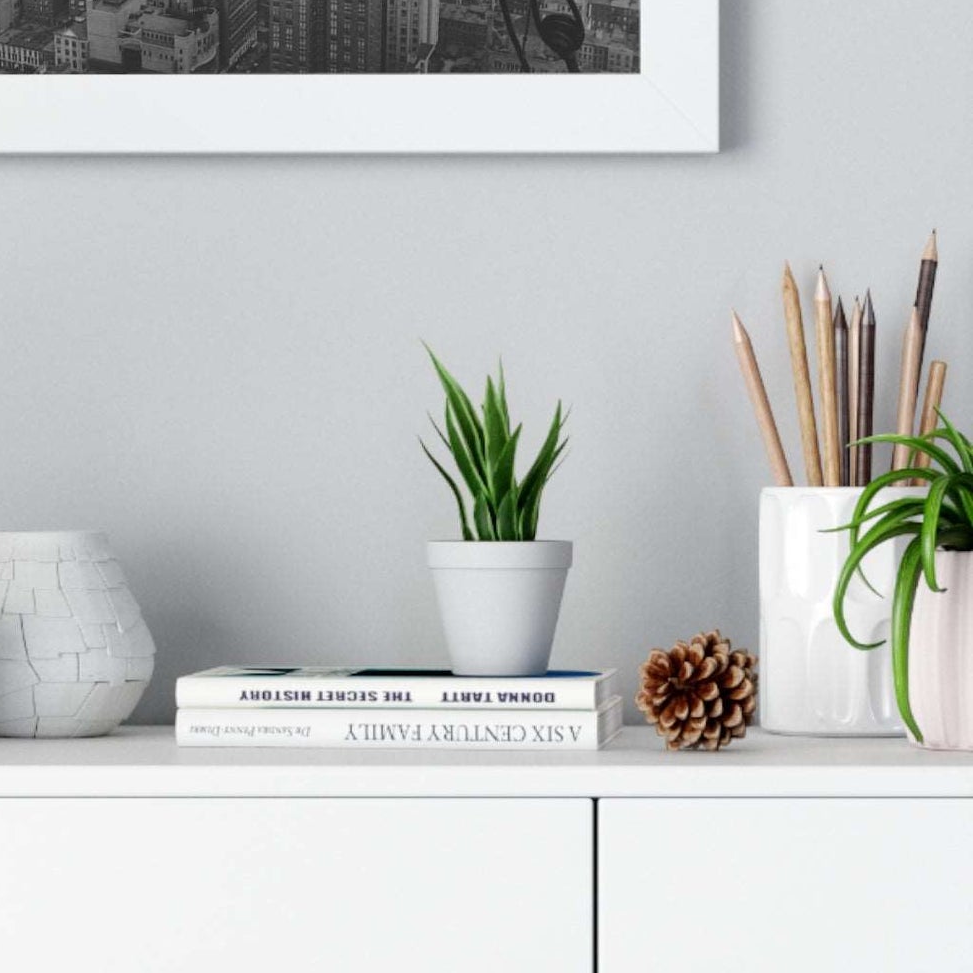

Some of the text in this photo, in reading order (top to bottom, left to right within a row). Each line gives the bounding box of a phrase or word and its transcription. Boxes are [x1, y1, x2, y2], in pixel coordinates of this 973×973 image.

[239, 690, 412, 702] THE SECRET HISTORY
[442, 691, 555, 703] DONNA TARTT
[344, 723, 583, 743] A SIX CENTURY FAMILY
